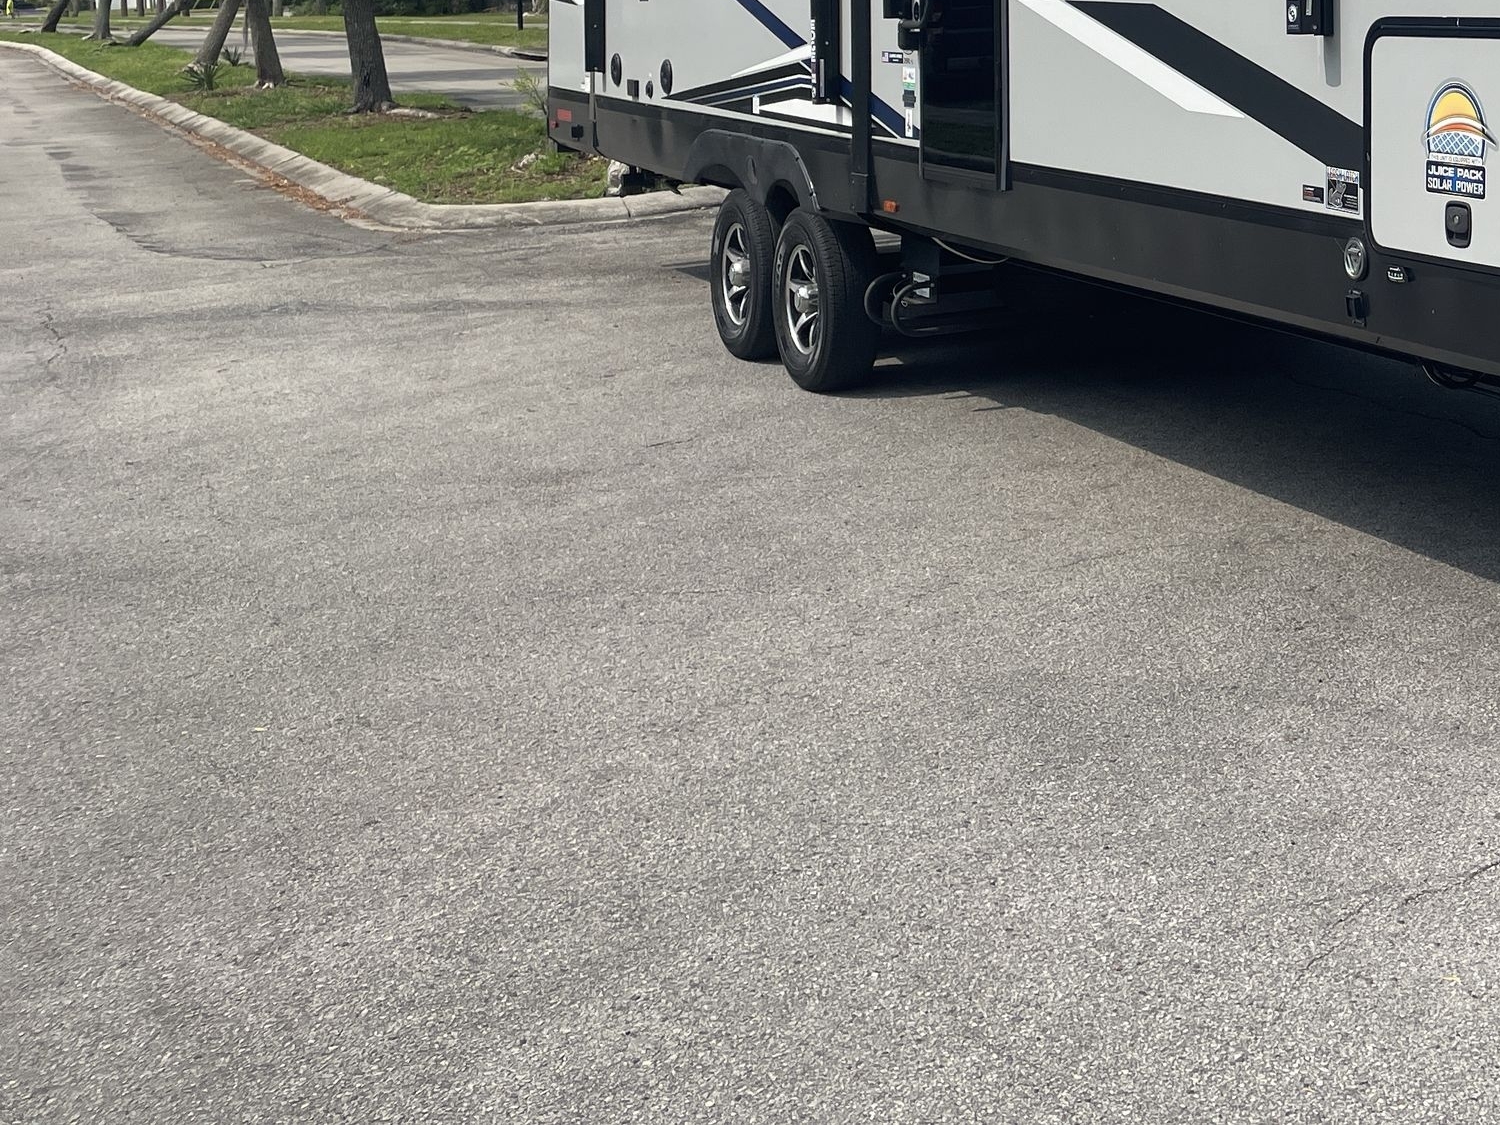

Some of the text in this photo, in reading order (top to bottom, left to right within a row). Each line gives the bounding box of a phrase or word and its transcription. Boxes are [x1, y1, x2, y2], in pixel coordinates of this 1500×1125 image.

[1428, 165, 1483, 181] JUICE PACK
[1427, 177, 1484, 195] SOLAR POWER
